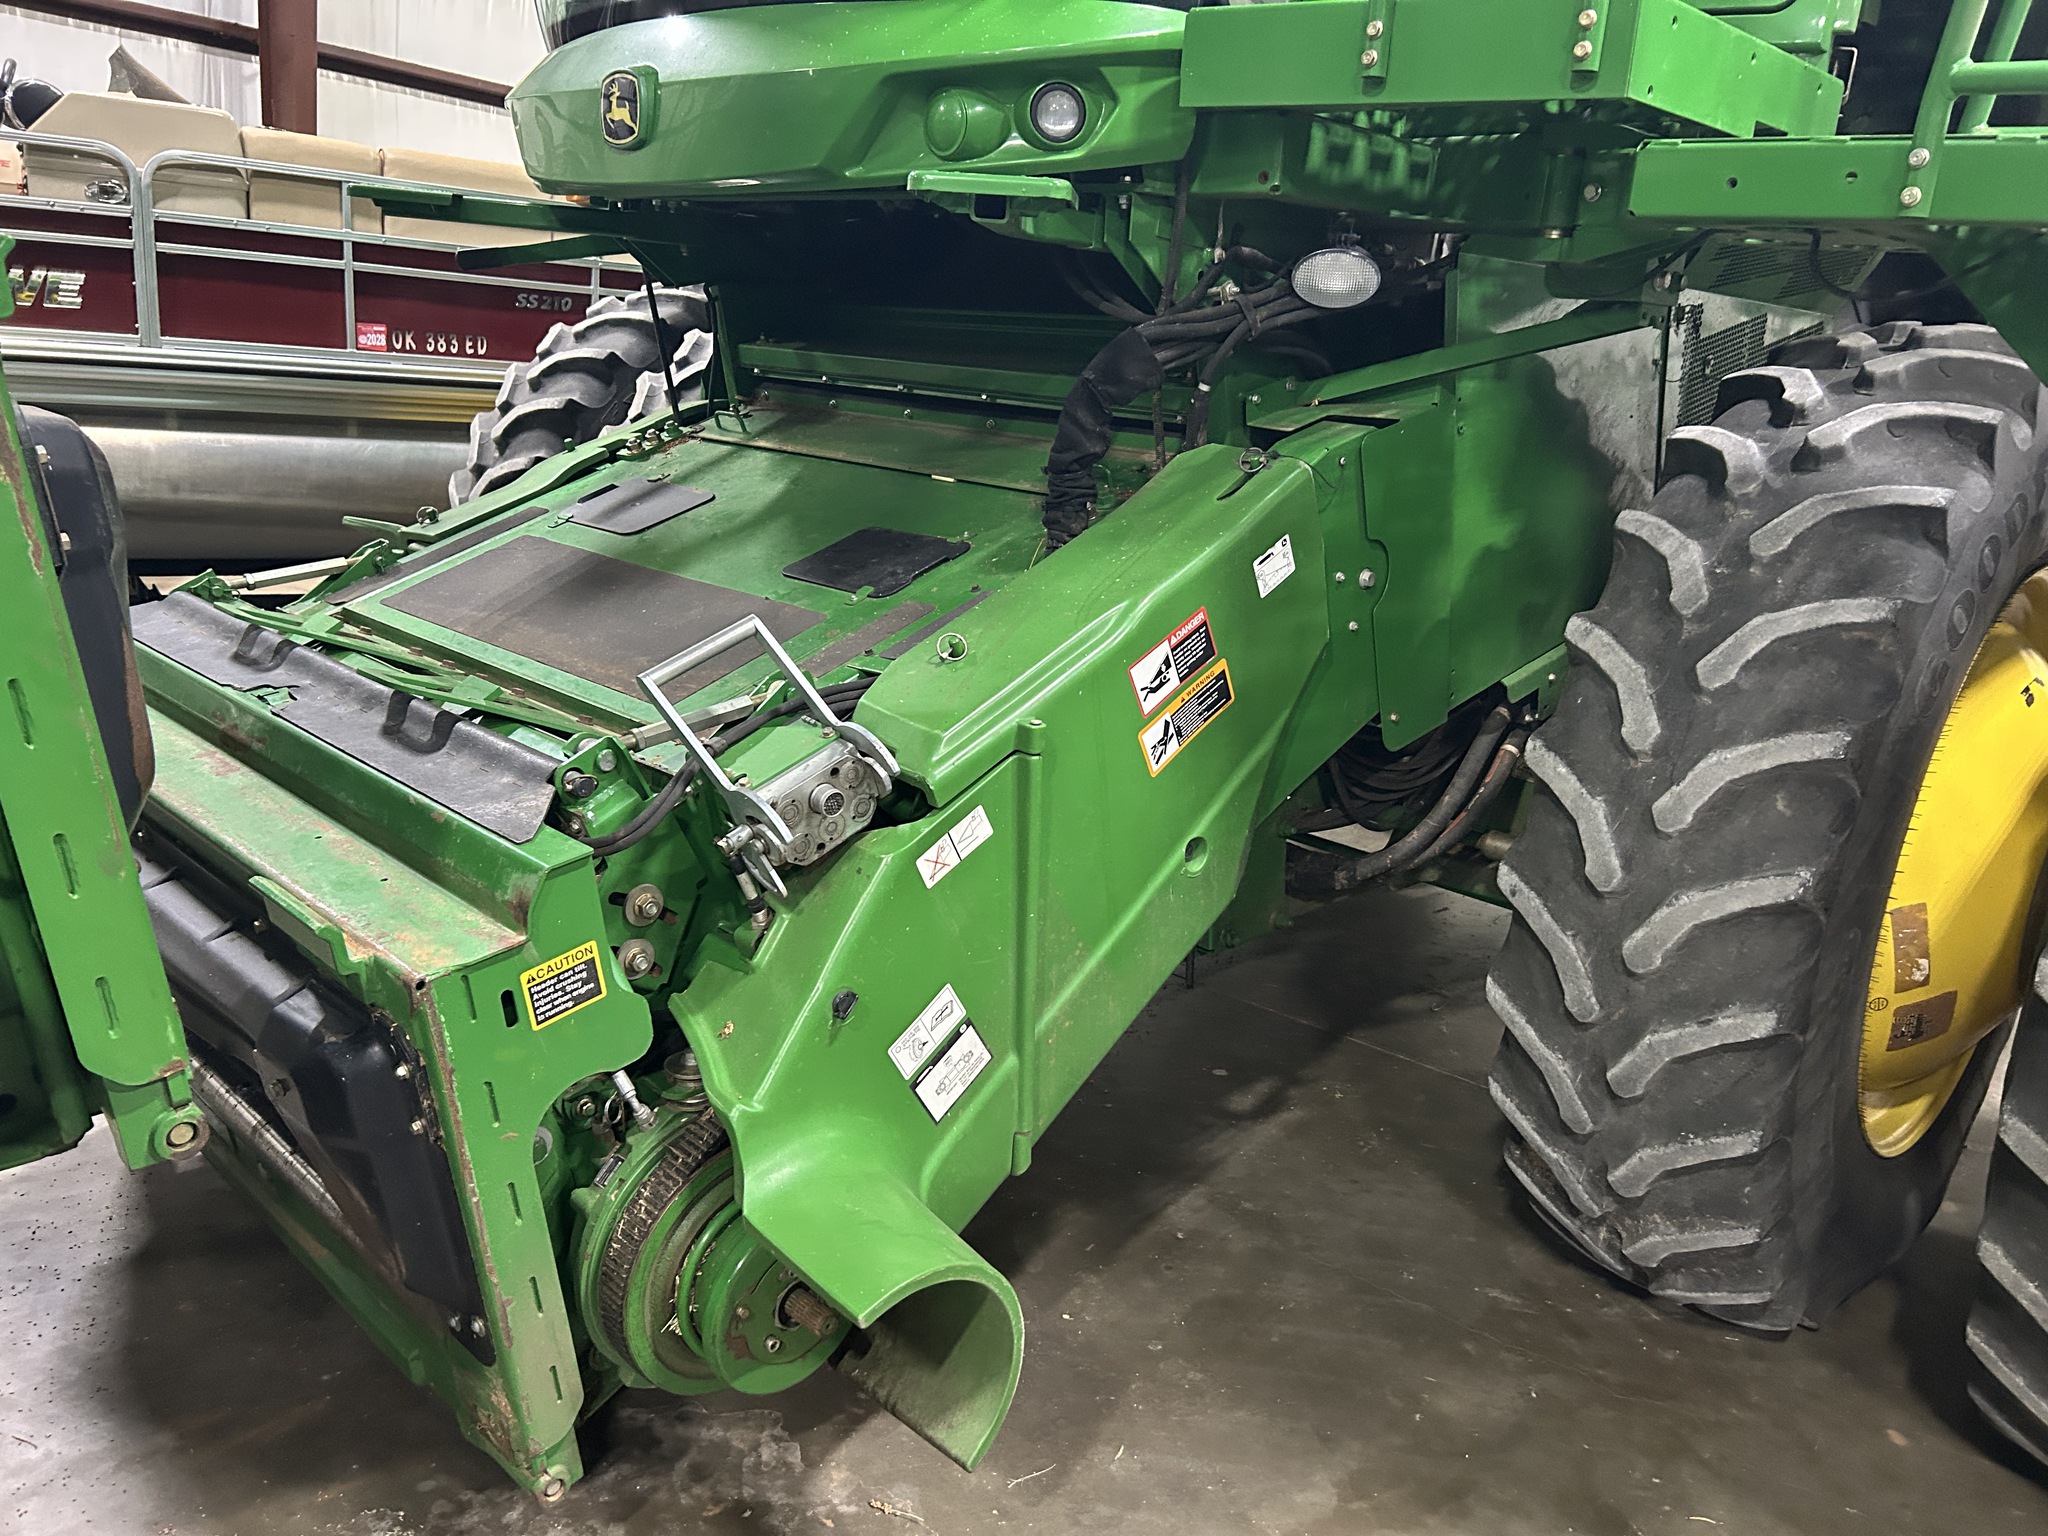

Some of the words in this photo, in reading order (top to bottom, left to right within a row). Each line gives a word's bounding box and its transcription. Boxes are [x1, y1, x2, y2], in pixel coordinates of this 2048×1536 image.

[8, 267, 86, 309] VE
[515, 293, 539, 309] SS
[541, 294, 572, 312] 210
[392, 330, 417, 350] OK
[426, 332, 459, 353] 383
[465, 334, 487, 355] ED
[1175, 611, 1205, 641] DANGER
[1185, 670, 1216, 697] WARNING
[536, 945, 594, 979] CAUTION
[530, 976, 558, 994] Header
[559, 969, 574, 981] can
[574, 963, 588, 973] tilt.
[532, 986, 555, 1001] Avoid
[555, 970, 587, 990] crushing
[565, 981, 583, 992] Stay
[536, 1003, 553, 1015] clear
[553, 994, 572, 1006] when
[571, 982, 595, 997] engine
